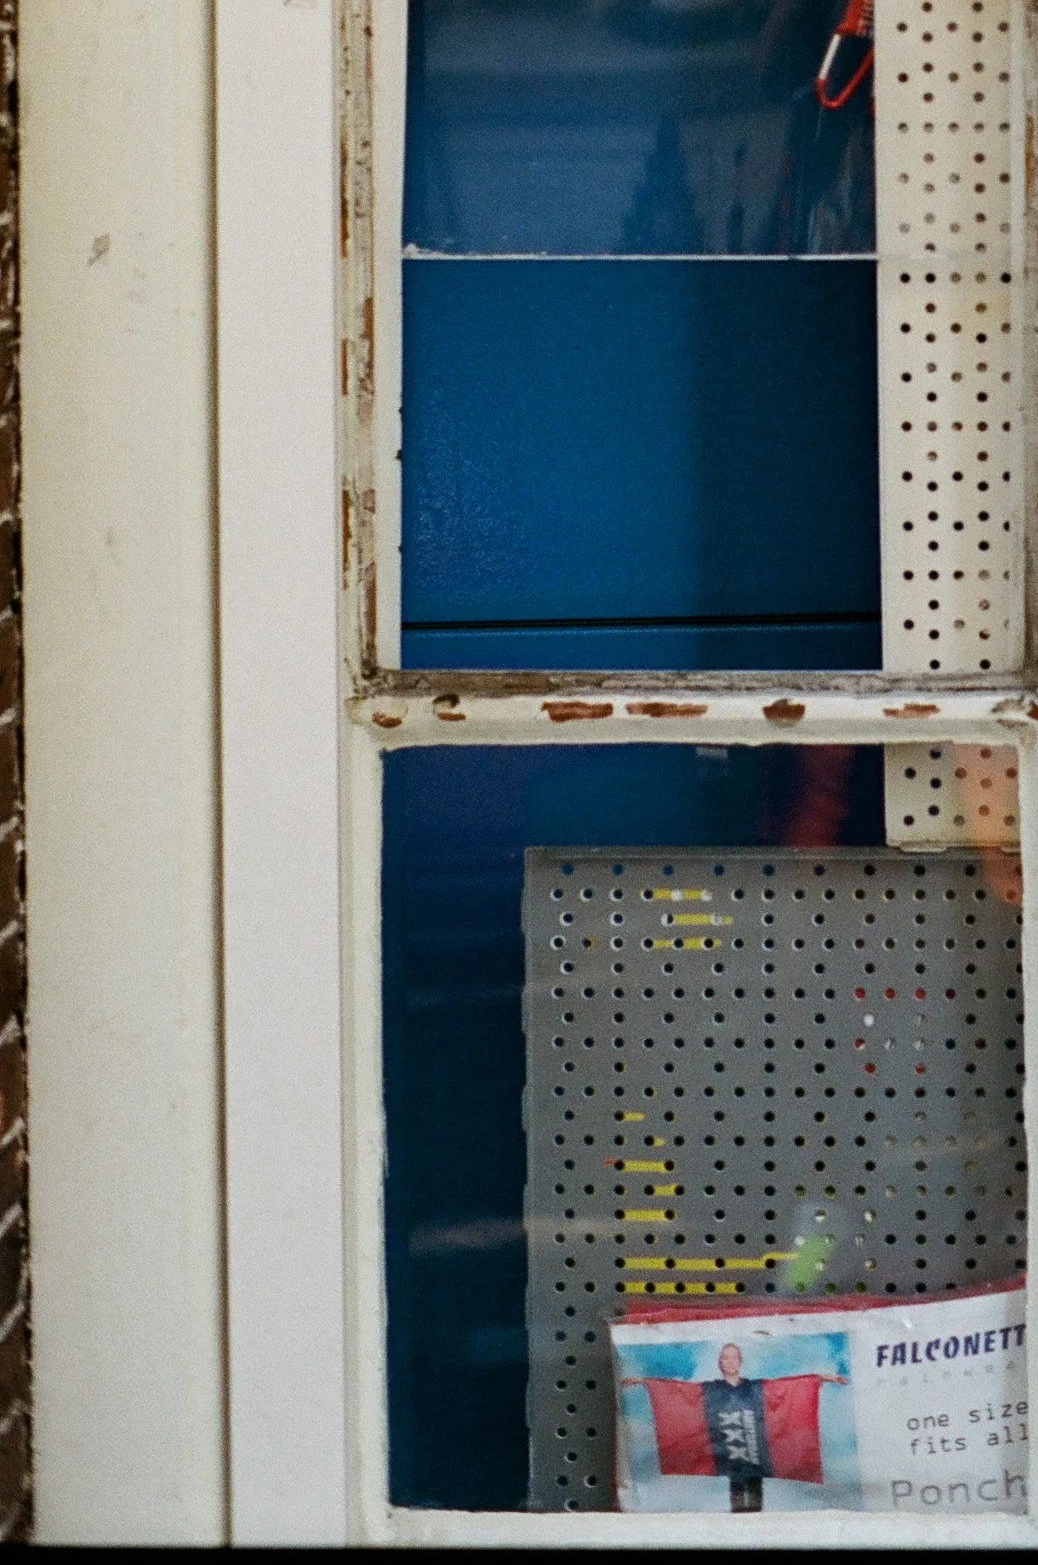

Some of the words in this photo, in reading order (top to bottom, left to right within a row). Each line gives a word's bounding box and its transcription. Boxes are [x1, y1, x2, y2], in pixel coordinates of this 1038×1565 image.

[876, 1323, 1026, 1367] FALCONETT
[907, 1413, 950, 1431] one
[968, 1401, 1028, 1424] size
[911, 1436, 967, 1455] fits
[987, 1423, 1028, 1446] all
[891, 1469, 1026, 1507] Ponch
